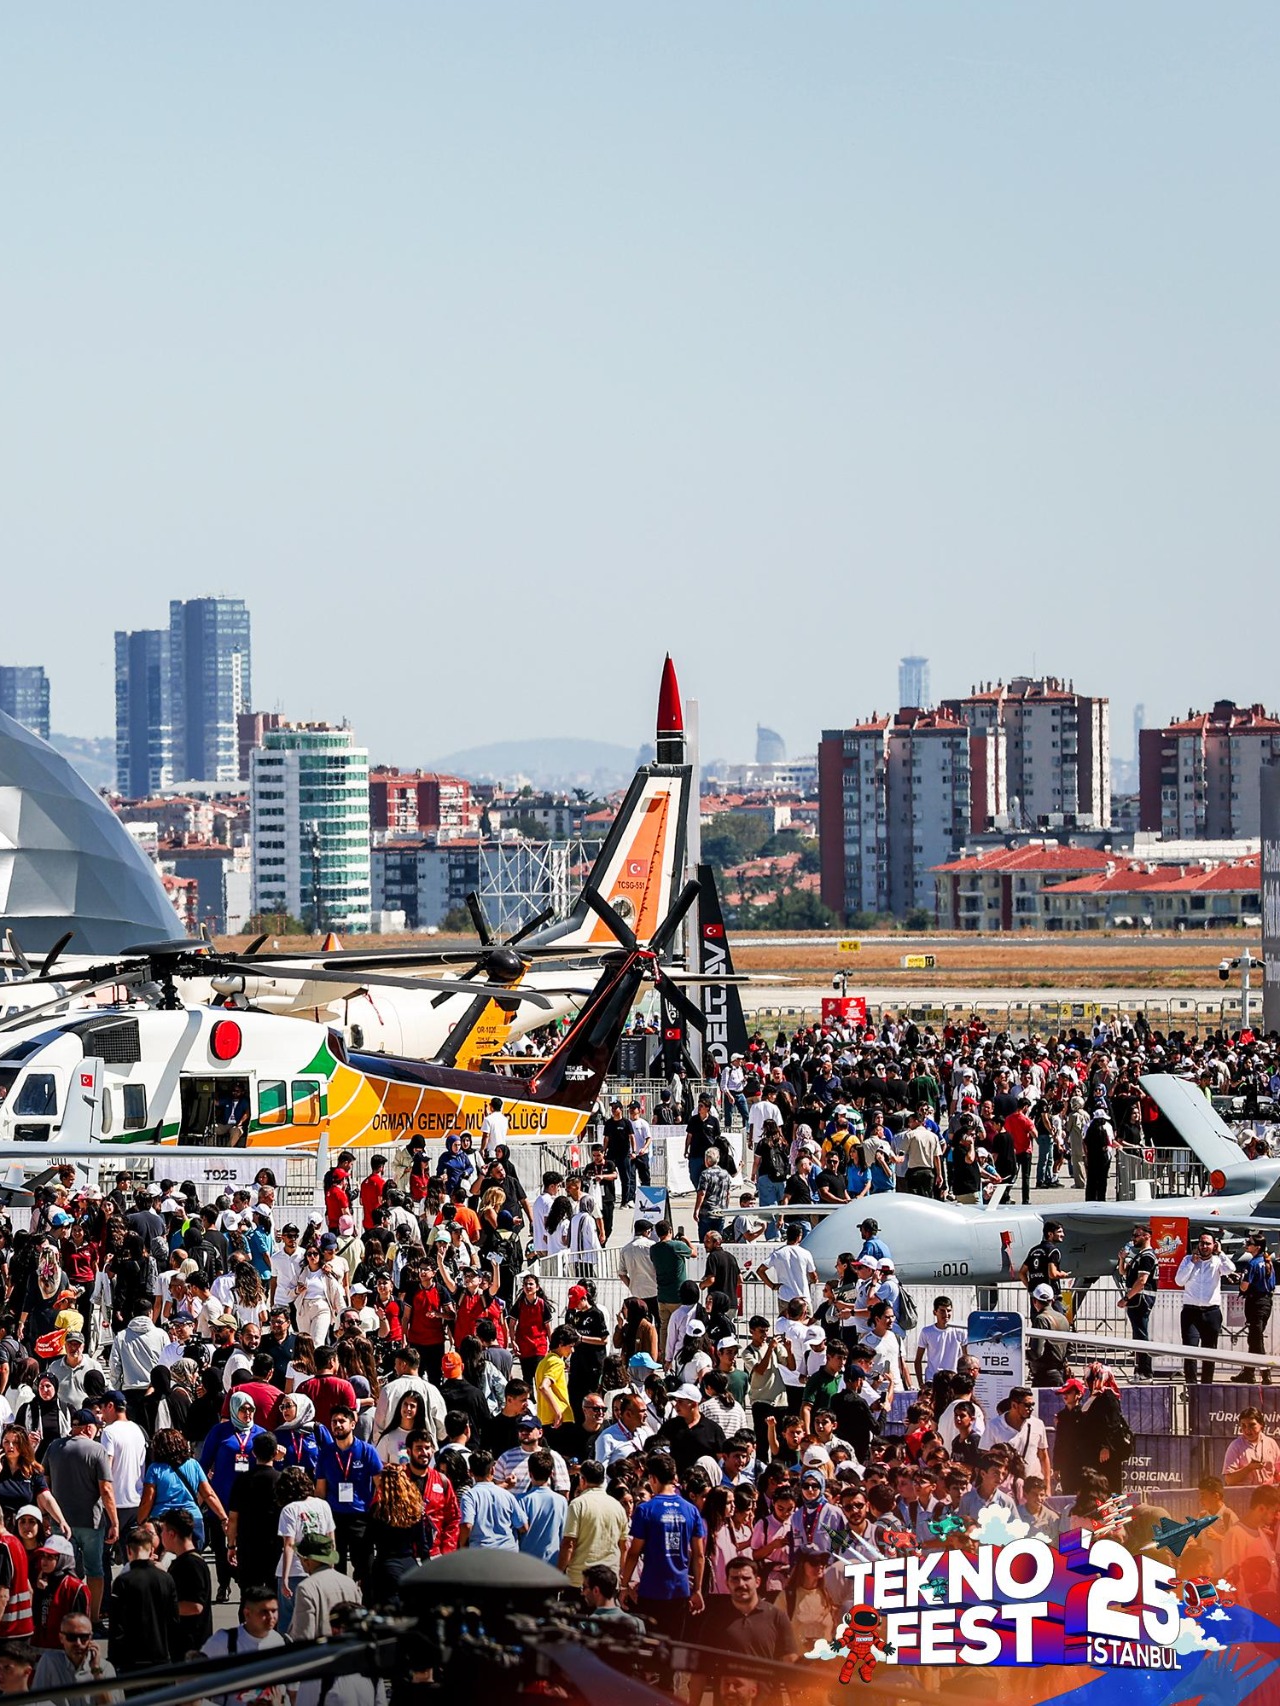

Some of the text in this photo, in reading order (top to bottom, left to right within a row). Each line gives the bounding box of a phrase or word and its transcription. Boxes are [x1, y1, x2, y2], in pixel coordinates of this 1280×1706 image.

[617, 881, 645, 889] TCSG-551
[373, 1108, 548, 1131] ORMAN GENEL MÜRLÜĞÜ
[204, 1169, 237, 1181] T925
[942, 1262, 969, 1277] 010
[982, 1356, 1009, 1366] TB2
[1130, 1471, 1181, 1482] ORIGINAL
